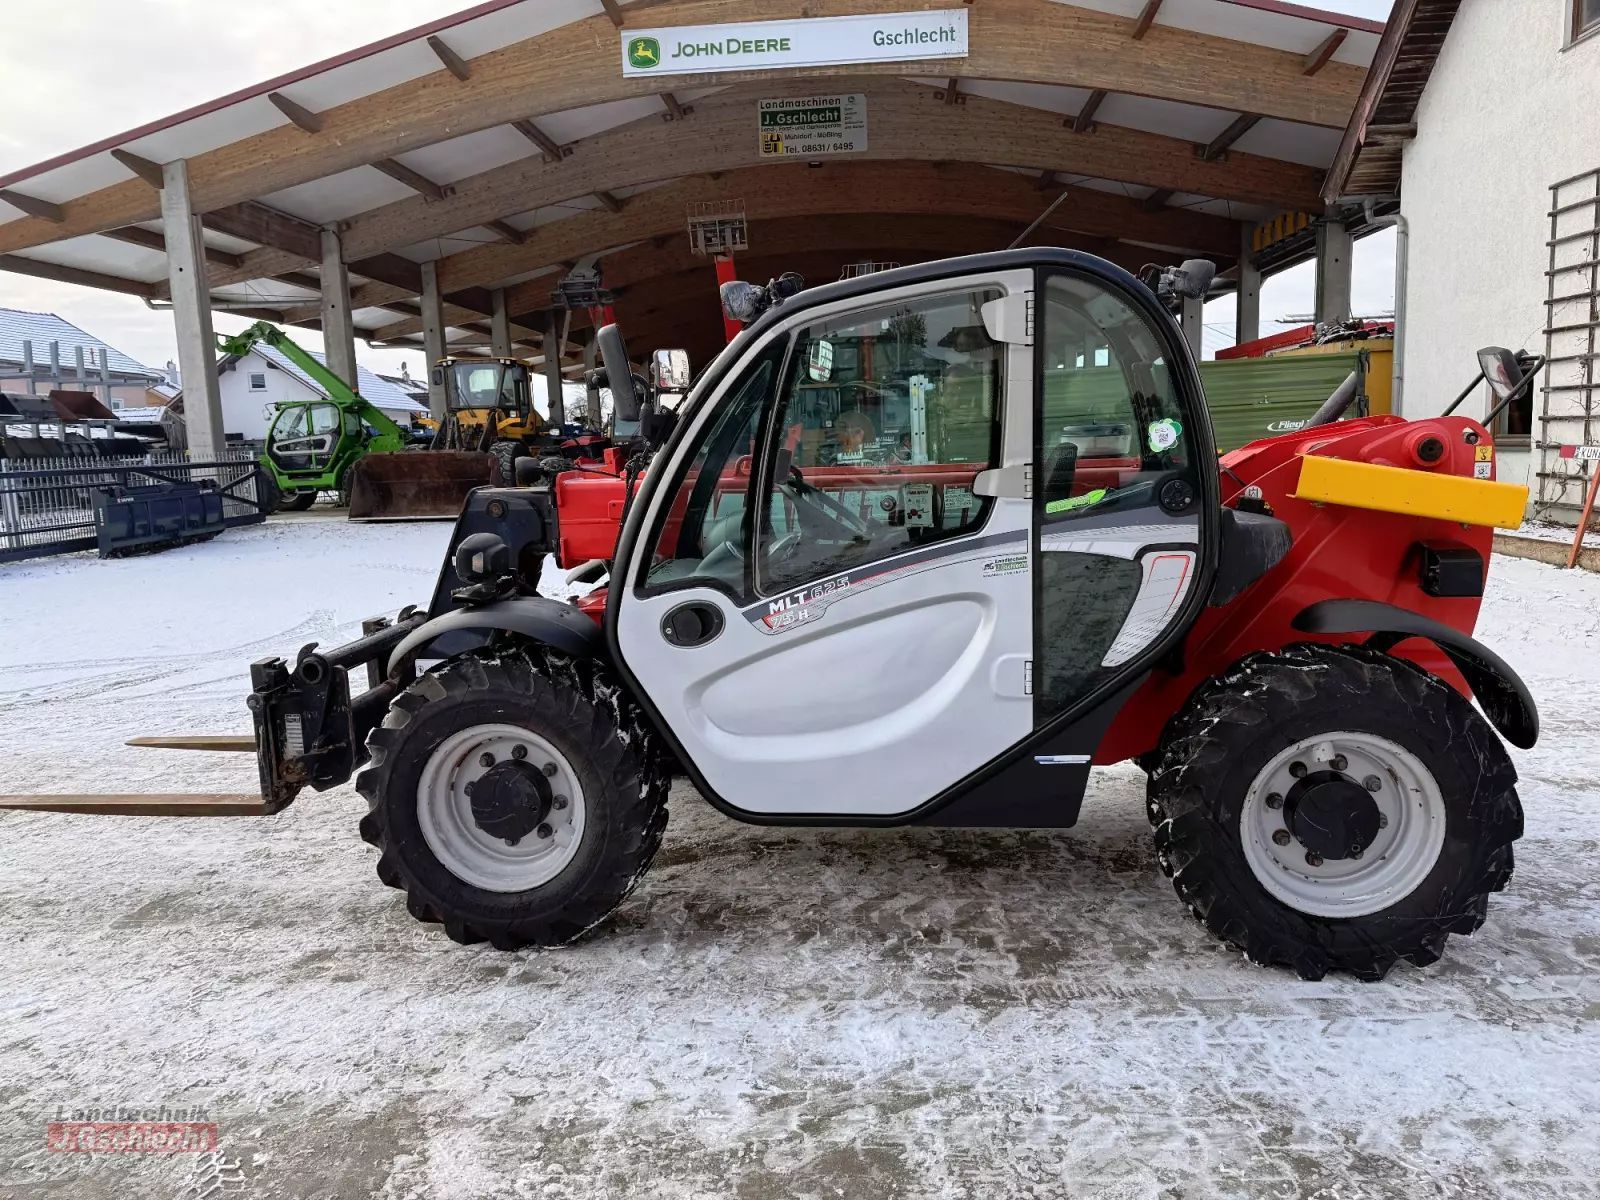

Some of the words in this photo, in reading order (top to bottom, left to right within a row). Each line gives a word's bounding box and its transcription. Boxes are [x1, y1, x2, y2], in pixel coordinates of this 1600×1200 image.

[873, 26, 956, 46] Gschlecht
[671, 42, 723, 58] JOHN
[726, 38, 791, 54] DEERE
[760, 98, 841, 110] Landmaschinen
[764, 113, 774, 125] J.
[776, 109, 839, 124] Gschlecht
[785, 145, 800, 154] Tel.
[1581, 447, 1600, 459] KUN
[769, 591, 808, 614] MLT
[810, 576, 850, 599] 625
[770, 611, 795, 630] 75
[798, 609, 809, 620] H
